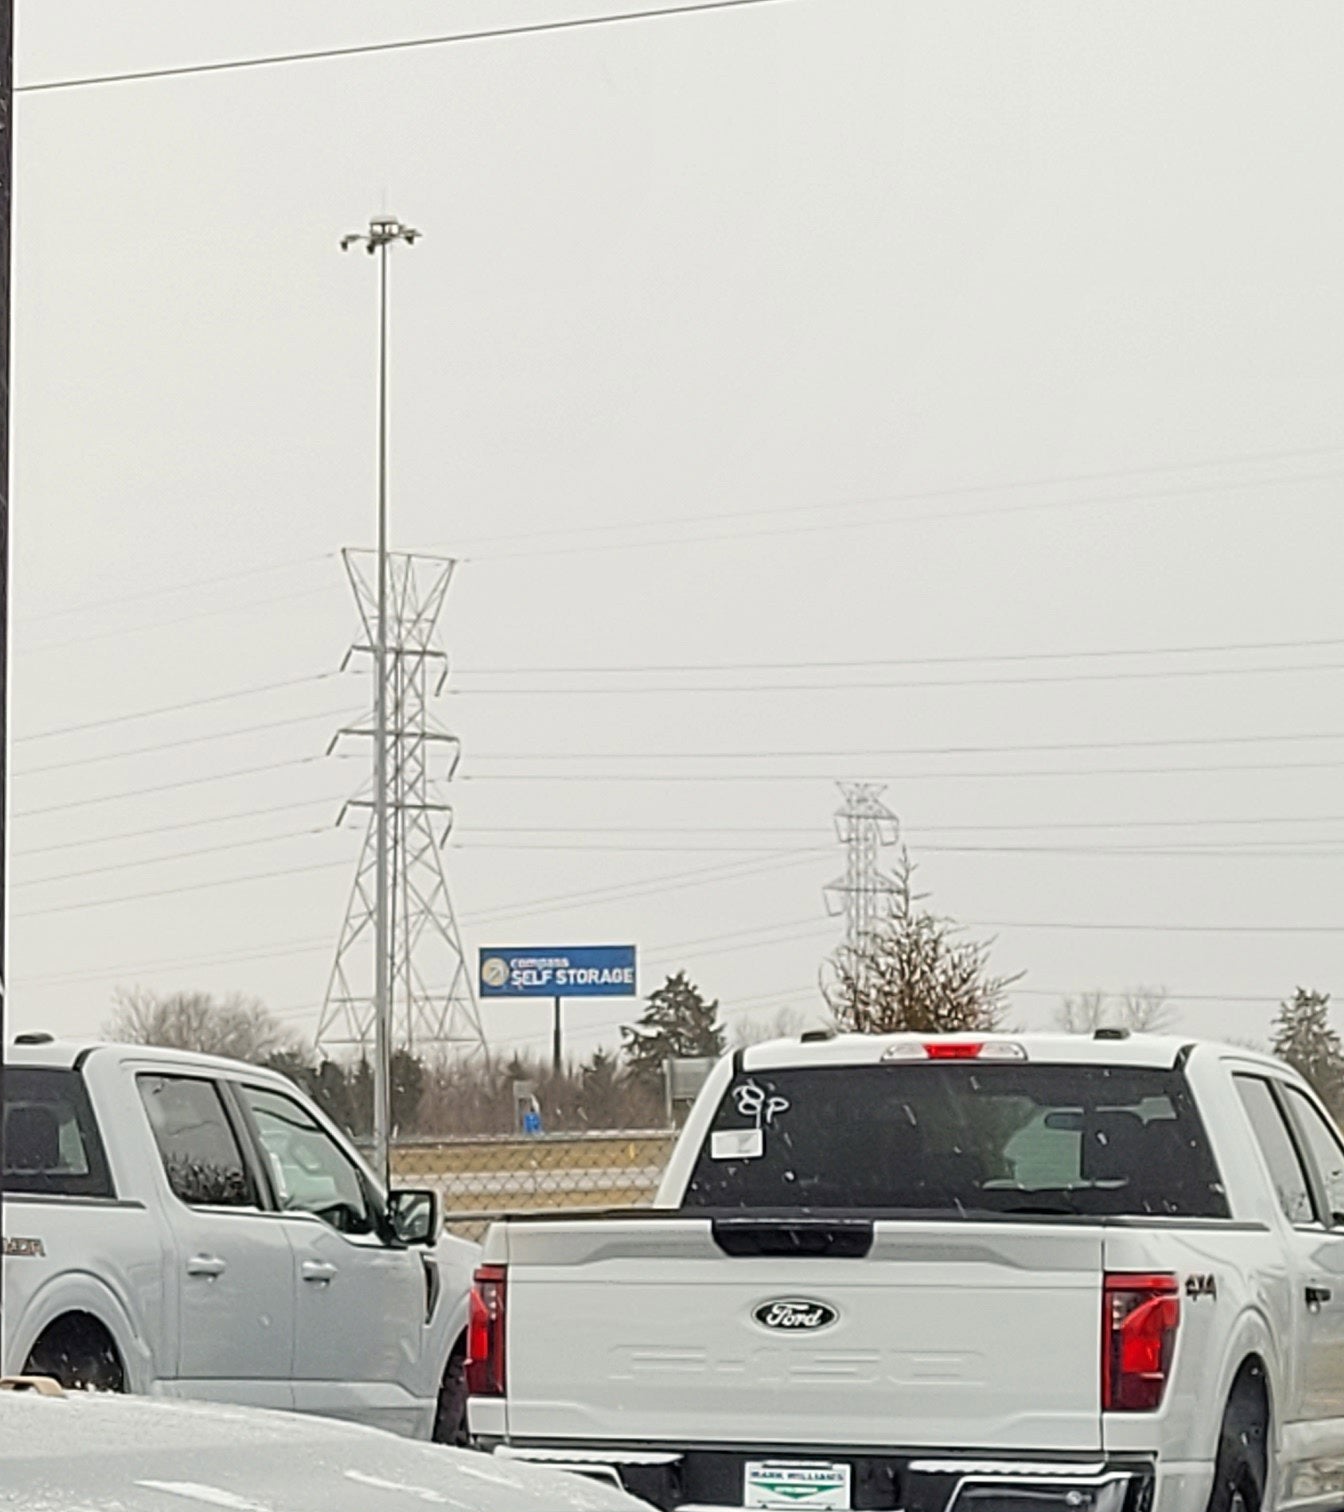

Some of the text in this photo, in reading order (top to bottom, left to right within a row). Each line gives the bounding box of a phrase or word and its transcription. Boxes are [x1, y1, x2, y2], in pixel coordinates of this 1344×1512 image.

[511, 967, 634, 986] SELF STORAGE
[764, 1301, 825, 1329] Ford
